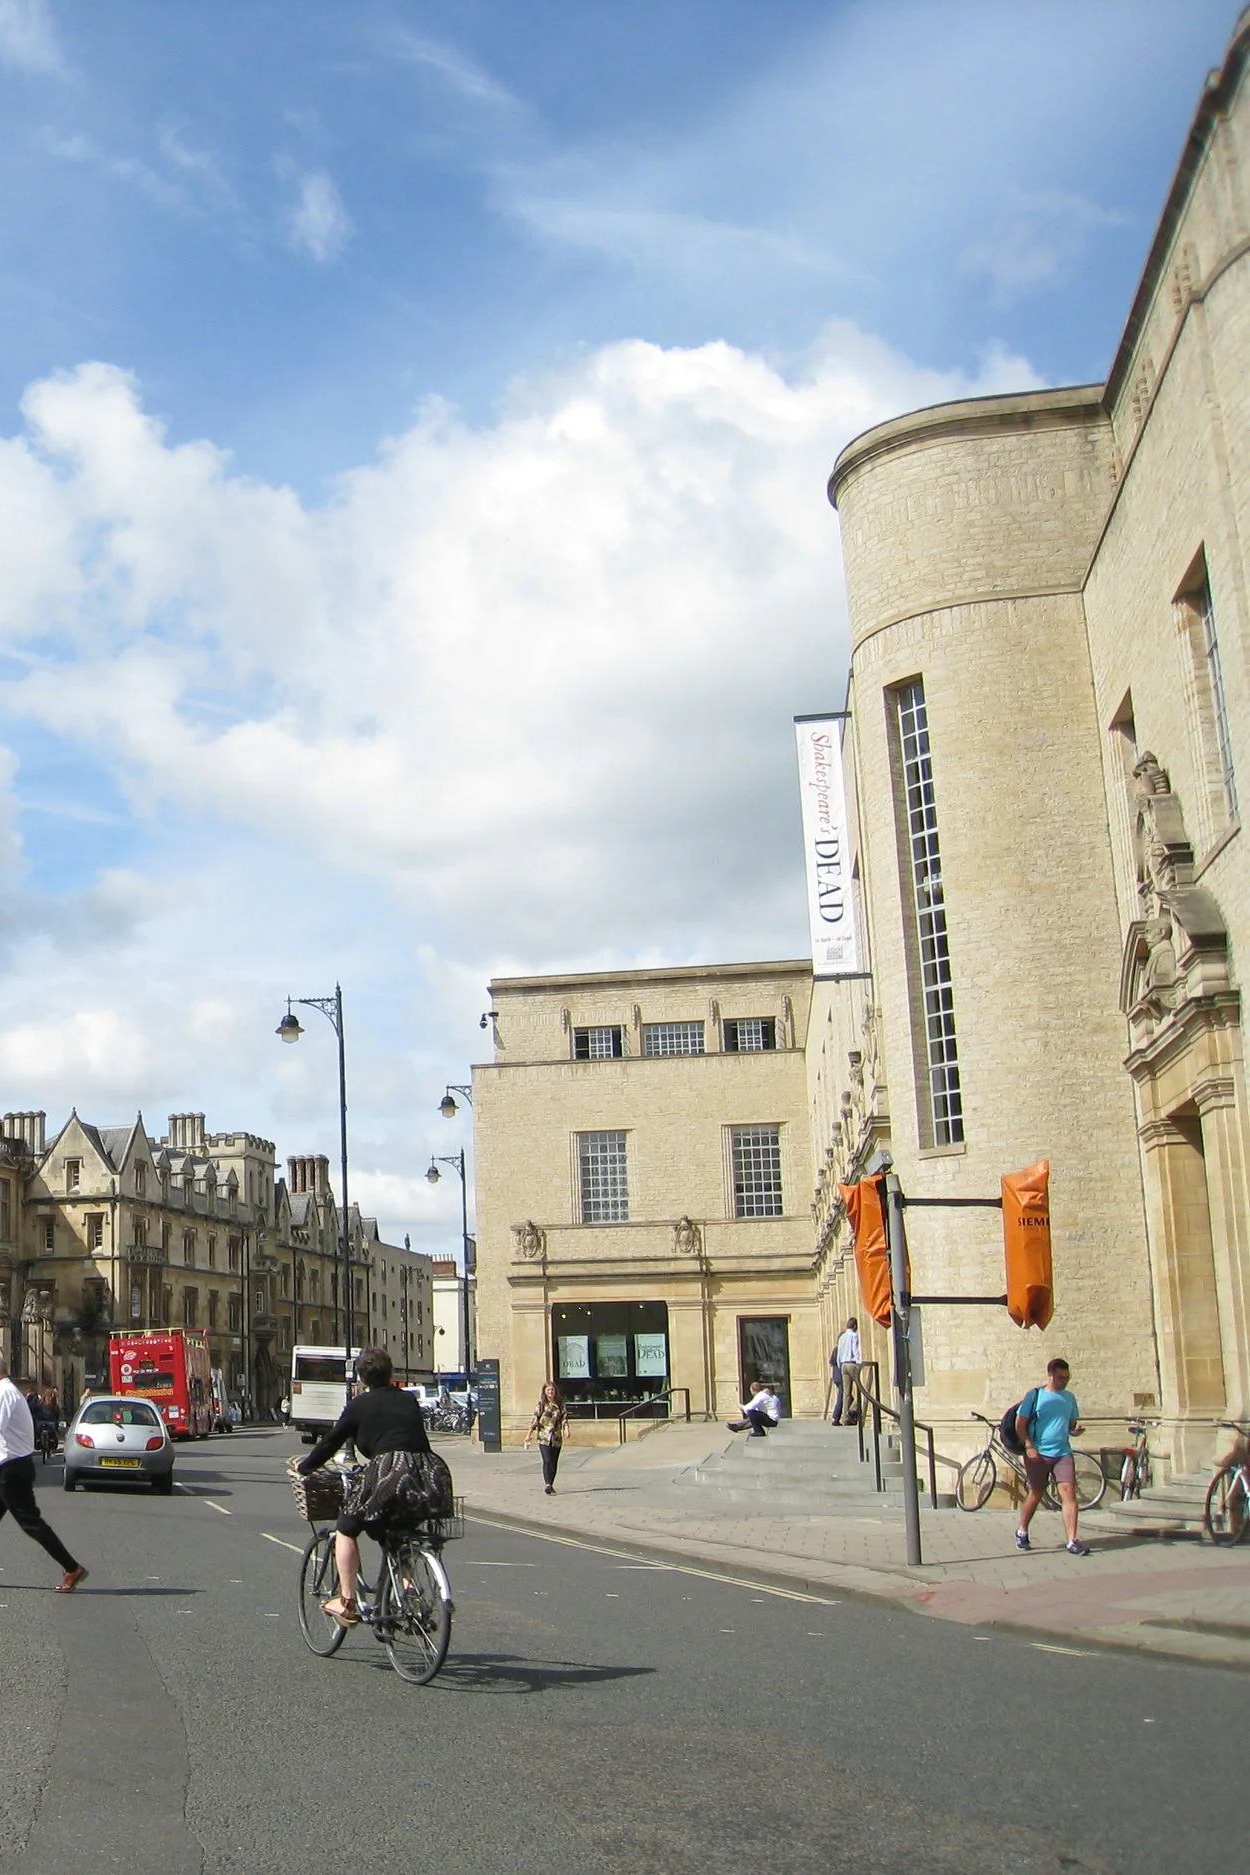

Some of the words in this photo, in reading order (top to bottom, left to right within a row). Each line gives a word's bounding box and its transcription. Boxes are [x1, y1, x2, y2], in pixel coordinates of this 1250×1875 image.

[809, 731, 838, 834] Shakespeare's
[815, 837, 844, 923] DEAD
[563, 1360, 586, 1368] DEAD
[637, 1348, 665, 1359] DEAD
